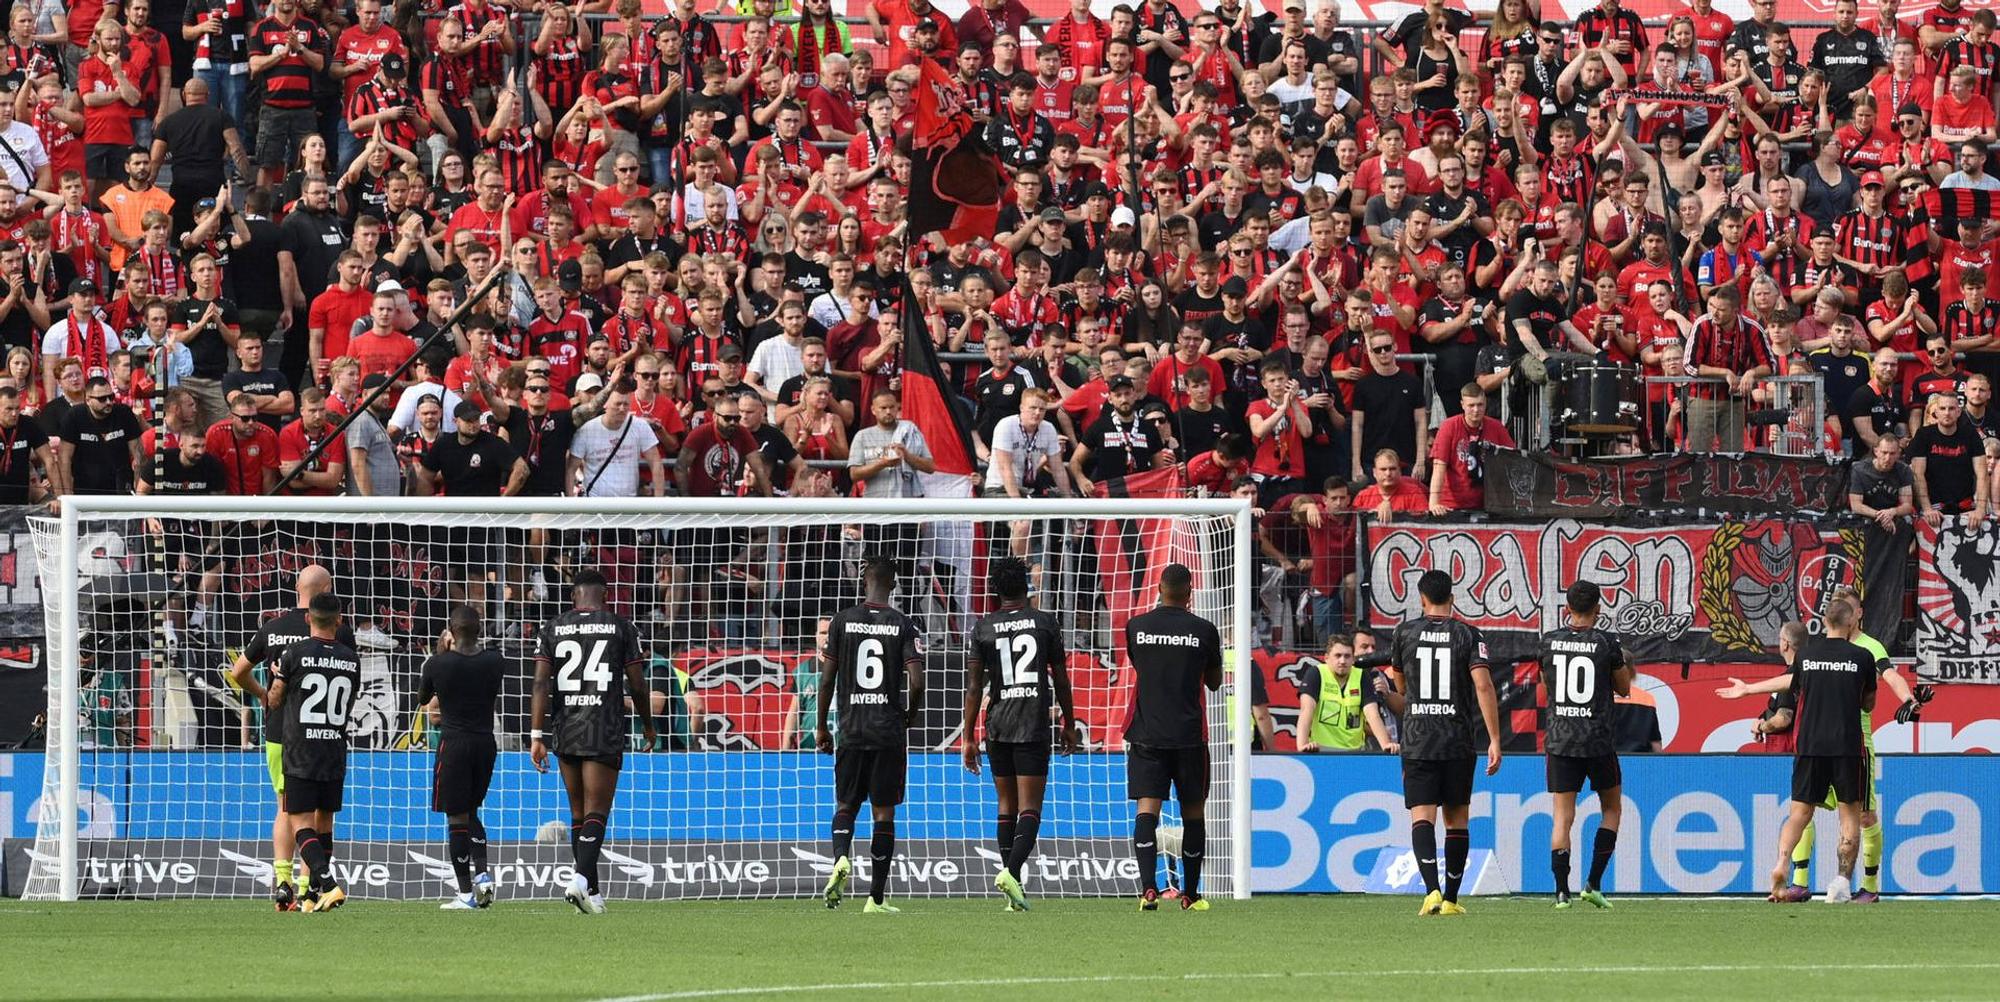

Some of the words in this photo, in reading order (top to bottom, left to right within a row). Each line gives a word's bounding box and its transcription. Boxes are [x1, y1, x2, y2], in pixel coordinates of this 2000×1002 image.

[1824, 55, 1868, 66] Barmenia
[1854, 237, 1891, 253] Barmenia
[548, 355, 569, 365] WE
[554, 623, 616, 636] FOSU-MENSAH
[845, 622, 900, 637] KOSSOUNOU
[993, 618, 1036, 632] TAPSOBA
[1136, 631, 1200, 648] Barmenia
[1419, 631, 1450, 643] AMIRI
[1550, 640, 1597, 654] DEMIRBAY
[554, 640, 613, 692] 24
[856, 638, 884, 690] 6
[995, 634, 1039, 687] 12
[1802, 659, 1858, 673] Barmenia
[1416, 646, 1451, 700] 11
[1552, 655, 1595, 704] 10
[299, 673, 352, 726] 20
[90, 853, 197, 884] trive
[661, 854, 770, 884] trive
[852, 853, 959, 884] tive
[1036, 852, 1141, 881] trive
